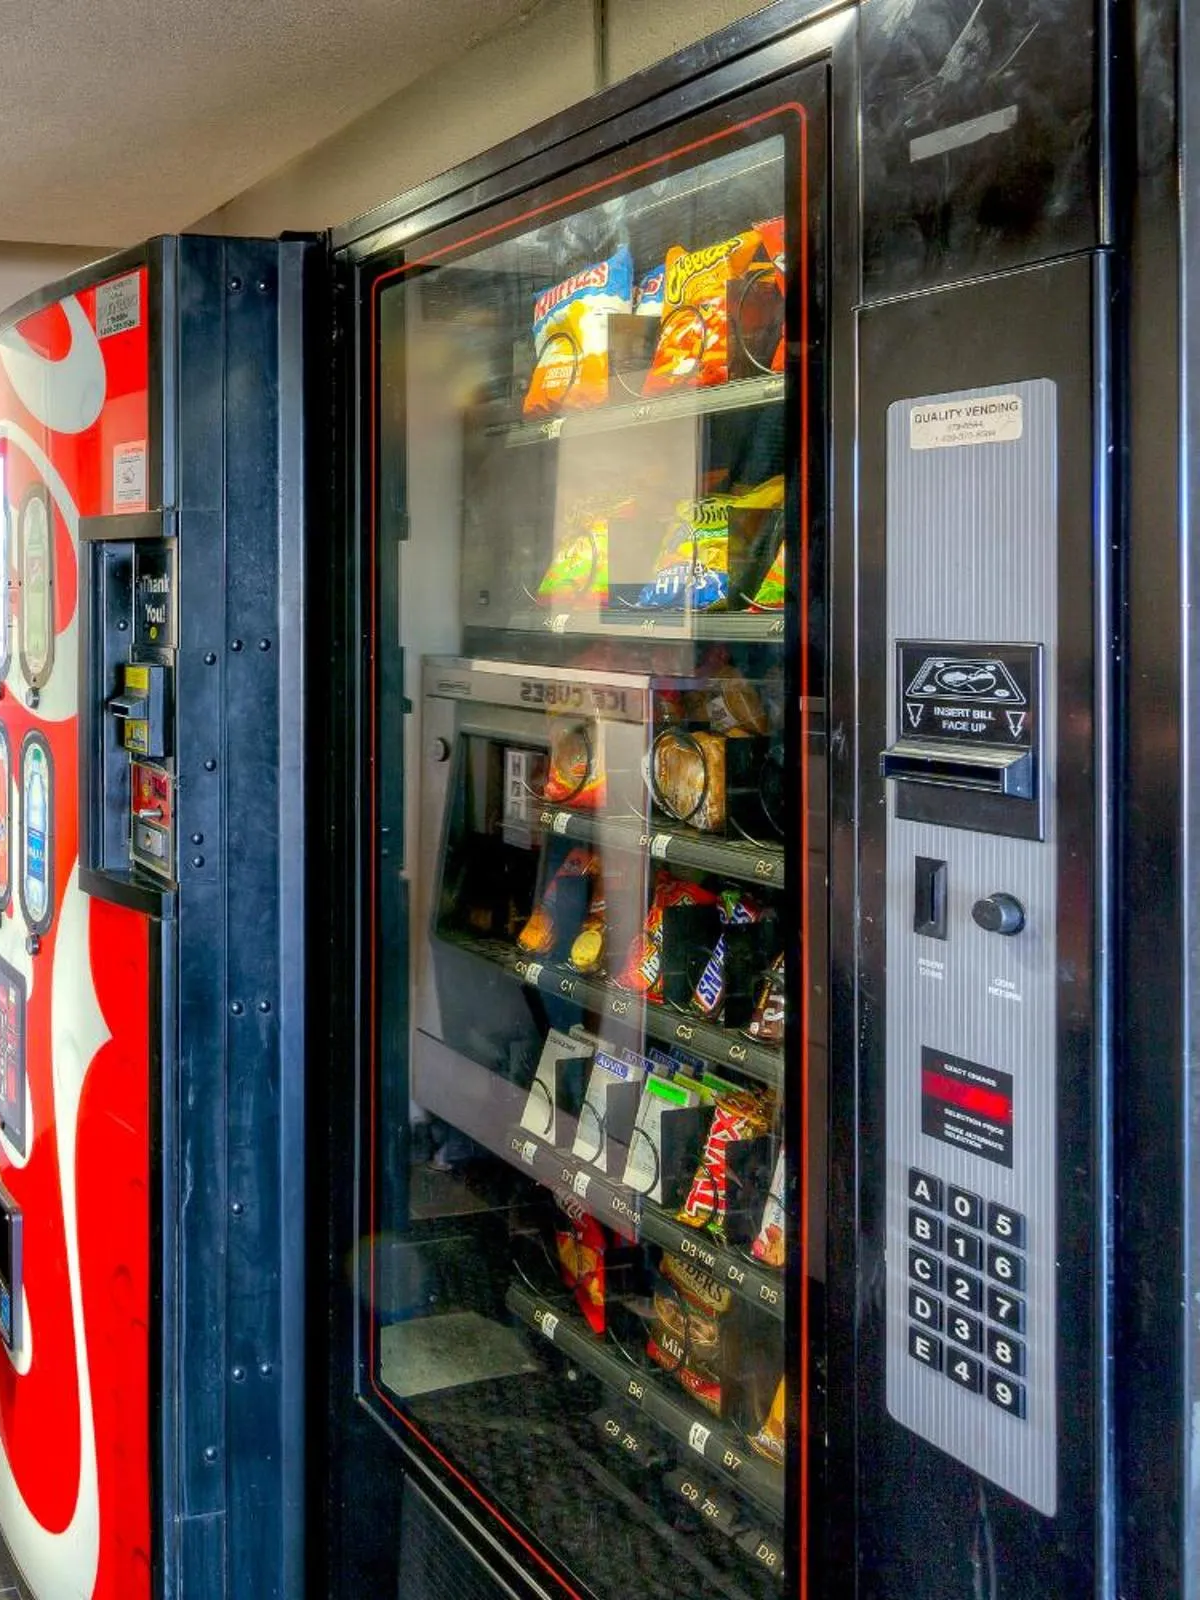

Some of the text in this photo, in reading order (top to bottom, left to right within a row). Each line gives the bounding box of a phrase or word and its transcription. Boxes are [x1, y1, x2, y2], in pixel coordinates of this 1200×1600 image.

[914, 401, 1019, 424] QUALITY VENDING
[141, 573, 171, 594] Thank
[145, 603, 166, 623] You!
[934, 706, 993, 720] INSERT BILL
[942, 719, 987, 733] FACE UP
[754, 860, 774, 877] B2
[612, 999, 628, 1014] C2
[676, 1024, 693, 1040] C3
[729, 1045, 746, 1061] C4
[597, 1056, 625, 1078] ADVIL
[944, 1063, 967, 1077] EXACT
[944, 1107, 1004, 1136] SELECTION PRICE
[944, 1129, 982, 1149] SELECTION
[915, 1180, 931, 1201] A
[612, 1197, 627, 1214] D2
[954, 1196, 971, 1217] 0
[915, 1217, 931, 1240] B
[995, 1214, 1012, 1236] 5
[681, 1239, 697, 1257] D3
[954, 1237, 965, 1258] 1
[728, 1265, 745, 1285] D4
[914, 1258, 931, 1280] C
[995, 1256, 1012, 1278] 6
[760, 1285, 778, 1304] D5
[954, 1278, 971, 1301] 2
[915, 1296, 931, 1319] D
[996, 1296, 1012, 1319] 7
[954, 1318, 971, 1341] 3
[915, 1336, 931, 1361] E
[996, 1340, 1012, 1364] 8
[954, 1360, 971, 1382] 4
[628, 1381, 644, 1400] B6
[996, 1382, 1012, 1405] 9
[604, 1420, 620, 1437] C8
[723, 1451, 741, 1470] B7
[680, 1482, 698, 1500] C9
[756, 1544, 777, 1566] D8
